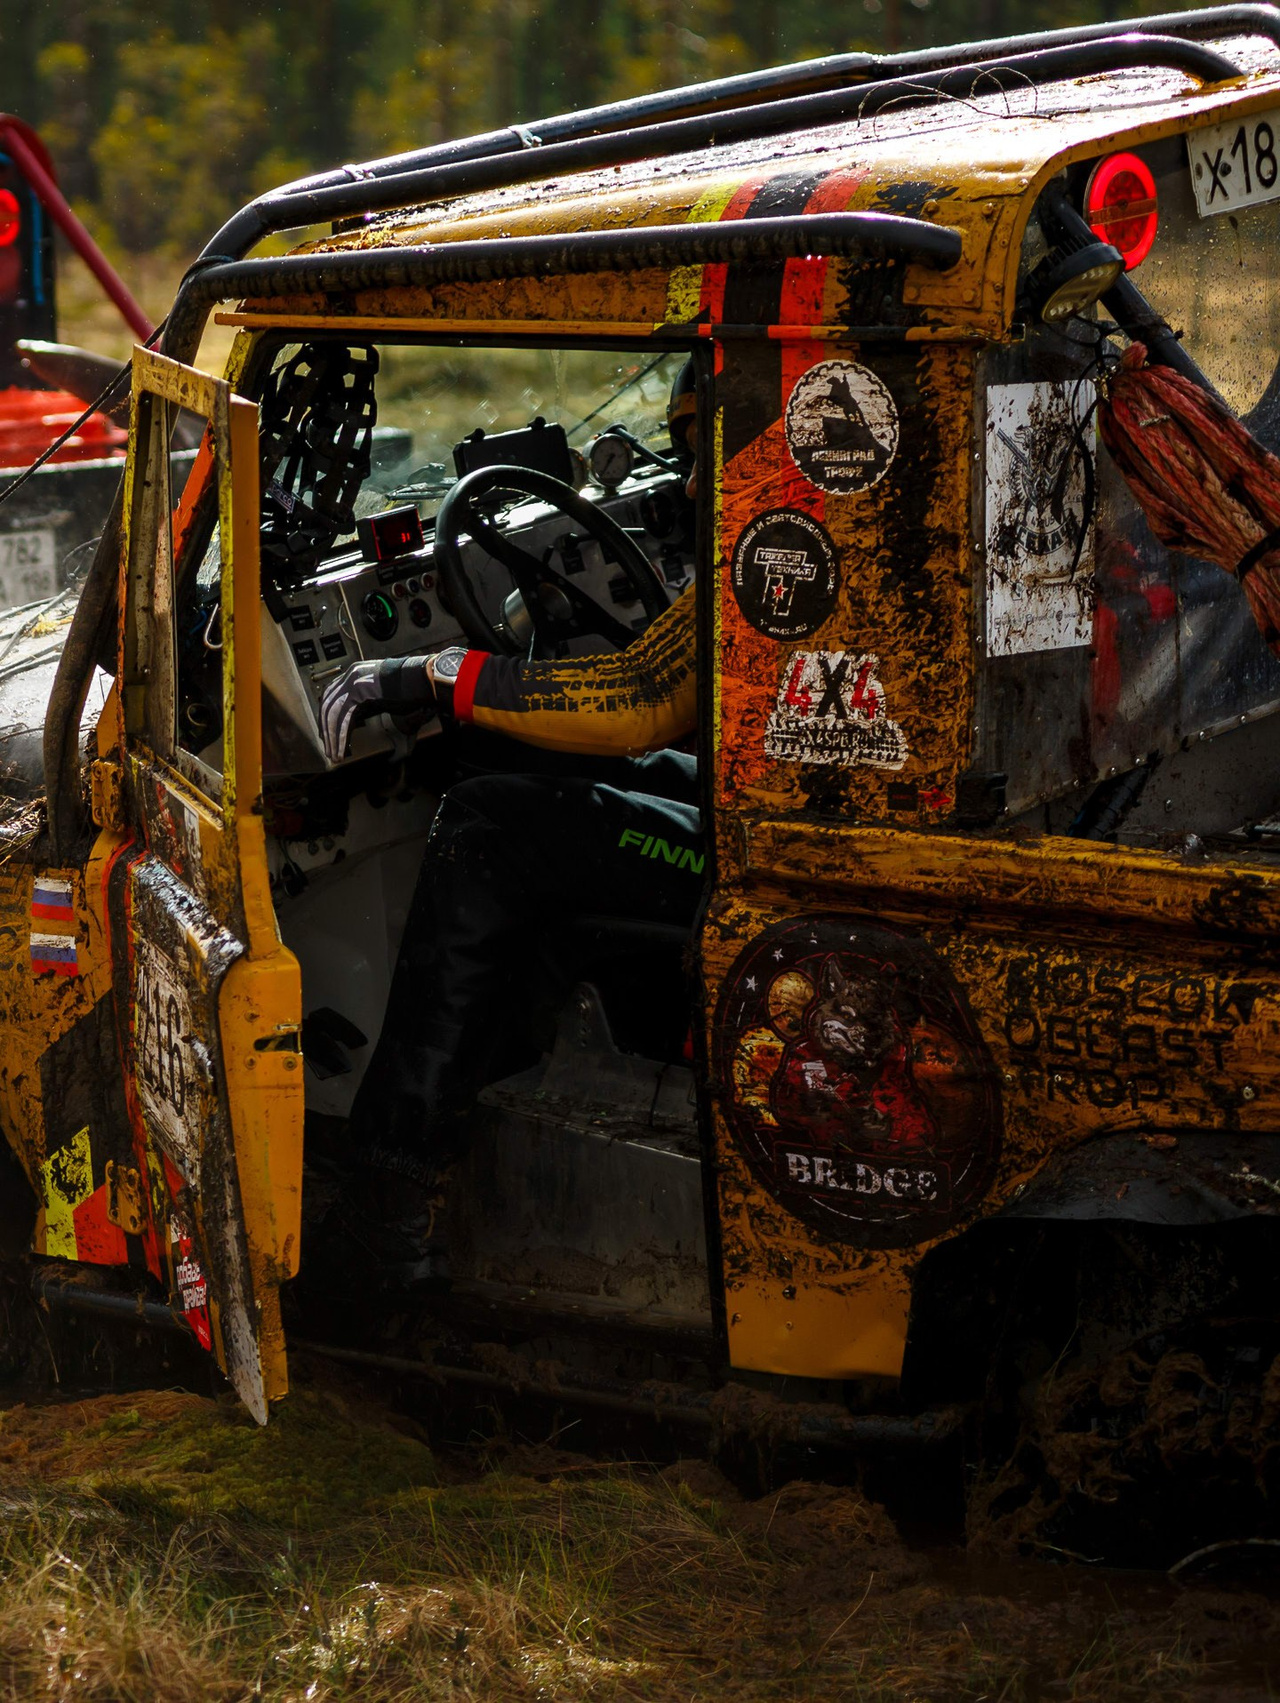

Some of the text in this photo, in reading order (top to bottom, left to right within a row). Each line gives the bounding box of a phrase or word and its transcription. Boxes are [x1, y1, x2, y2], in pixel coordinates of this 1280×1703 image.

[2, 535, 41, 566] 782
[784, 659, 880, 720] 4X4
[618, 828, 705, 875] FINN
[1004, 1014, 1234, 1071] OBLAST
